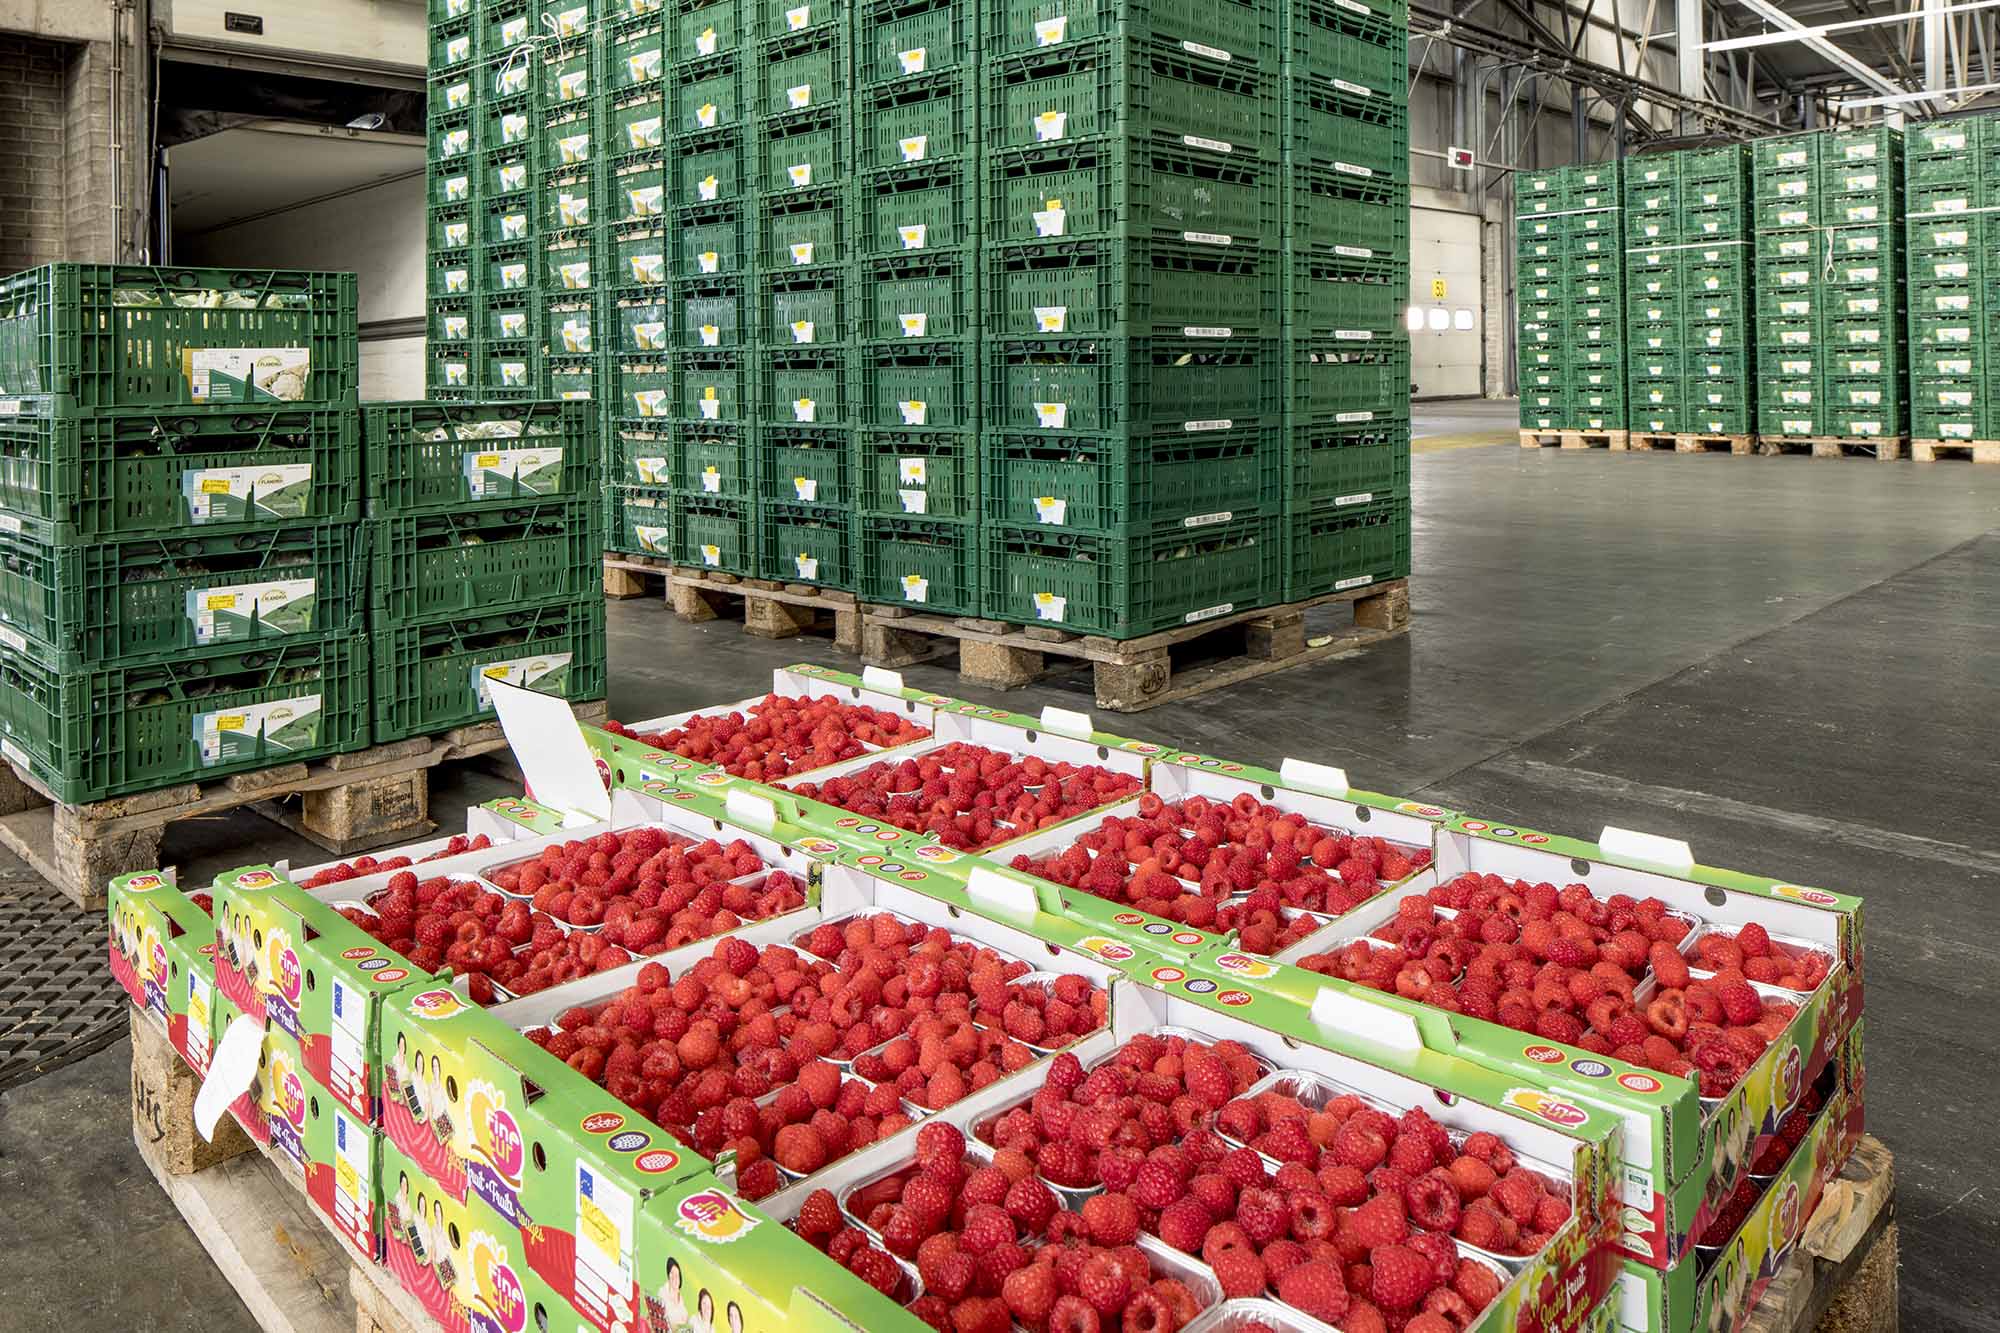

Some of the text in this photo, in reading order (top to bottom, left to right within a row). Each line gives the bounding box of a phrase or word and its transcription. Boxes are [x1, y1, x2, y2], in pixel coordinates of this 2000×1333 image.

[485, 1106, 521, 1147] Fine
[487, 1259, 523, 1303] Fine
[1565, 1261, 1587, 1313] fruit
